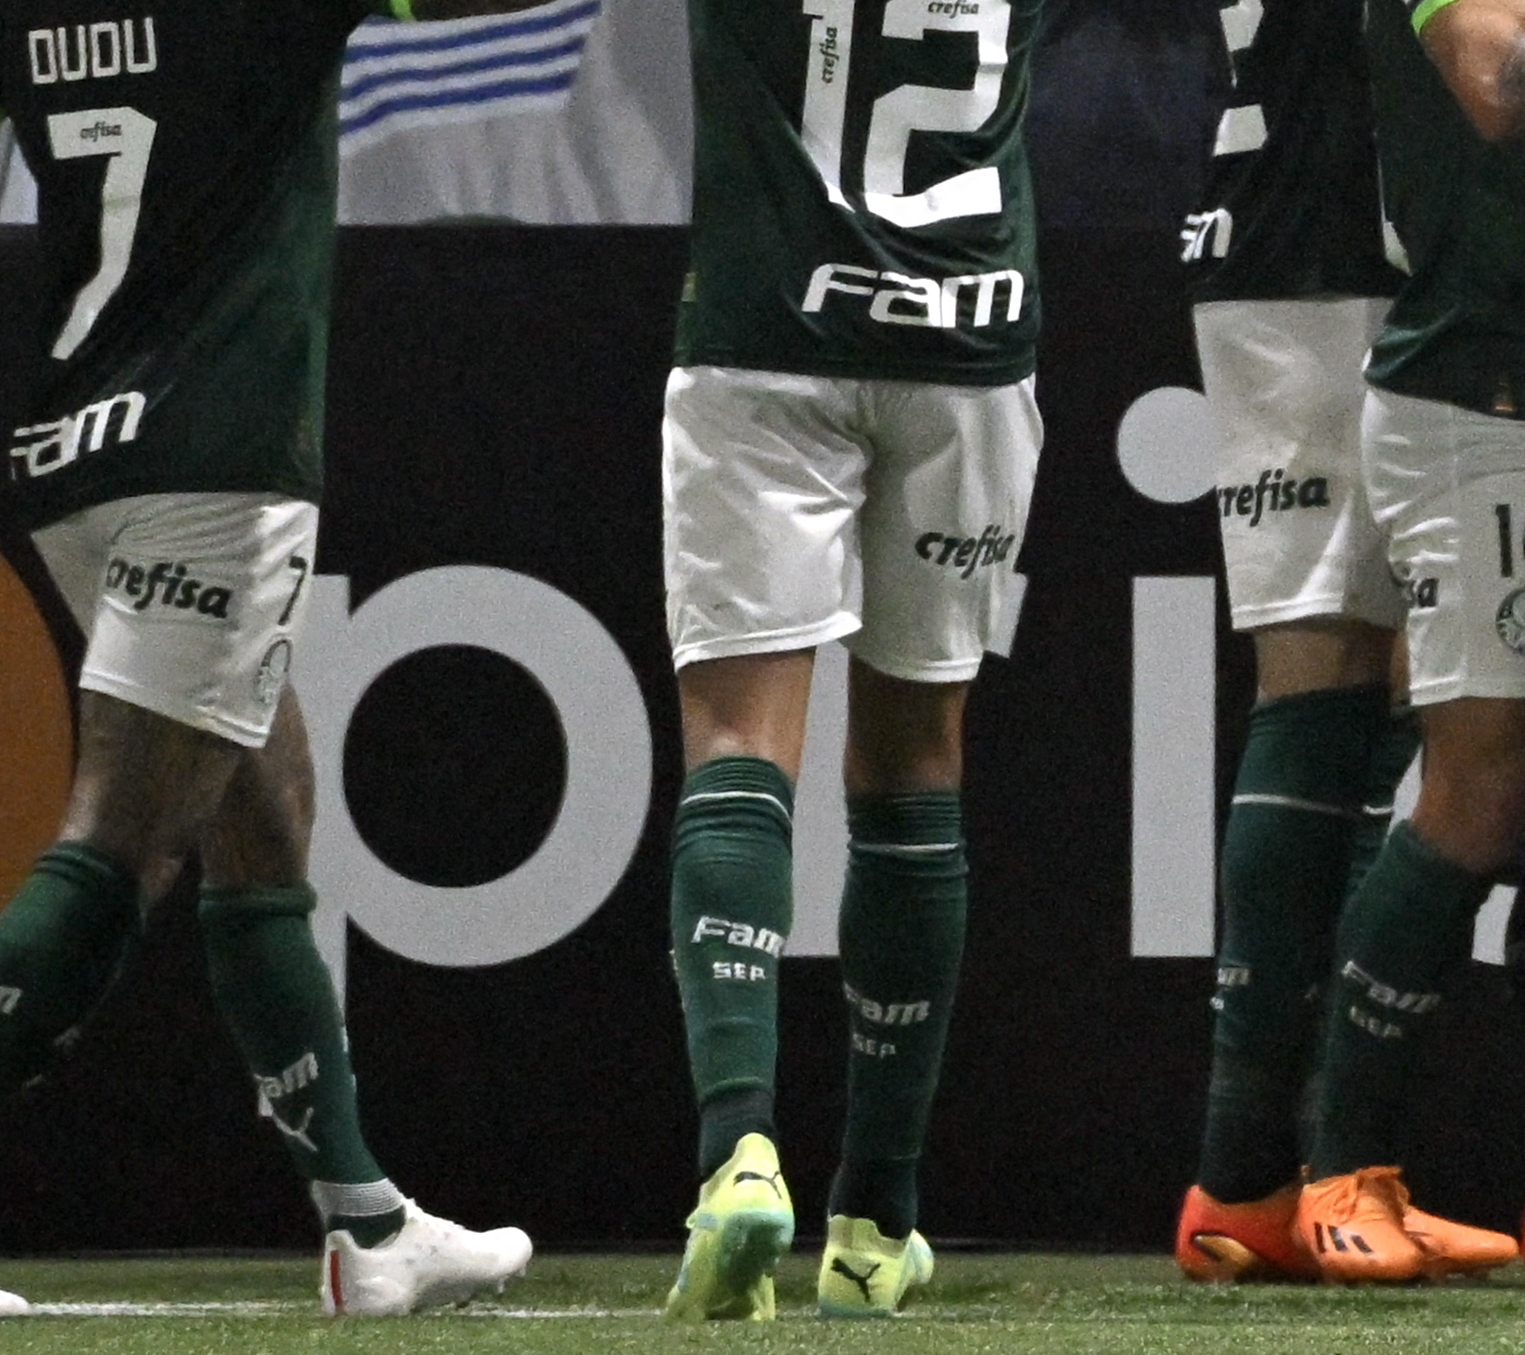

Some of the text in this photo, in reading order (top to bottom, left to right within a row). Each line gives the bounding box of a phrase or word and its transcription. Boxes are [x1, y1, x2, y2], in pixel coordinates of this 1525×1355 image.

[29, 17, 158, 86] DUDU
[820, 25, 839, 84] crefisa
[47, 106, 159, 360] 7
[277, 555, 307, 626] 7
